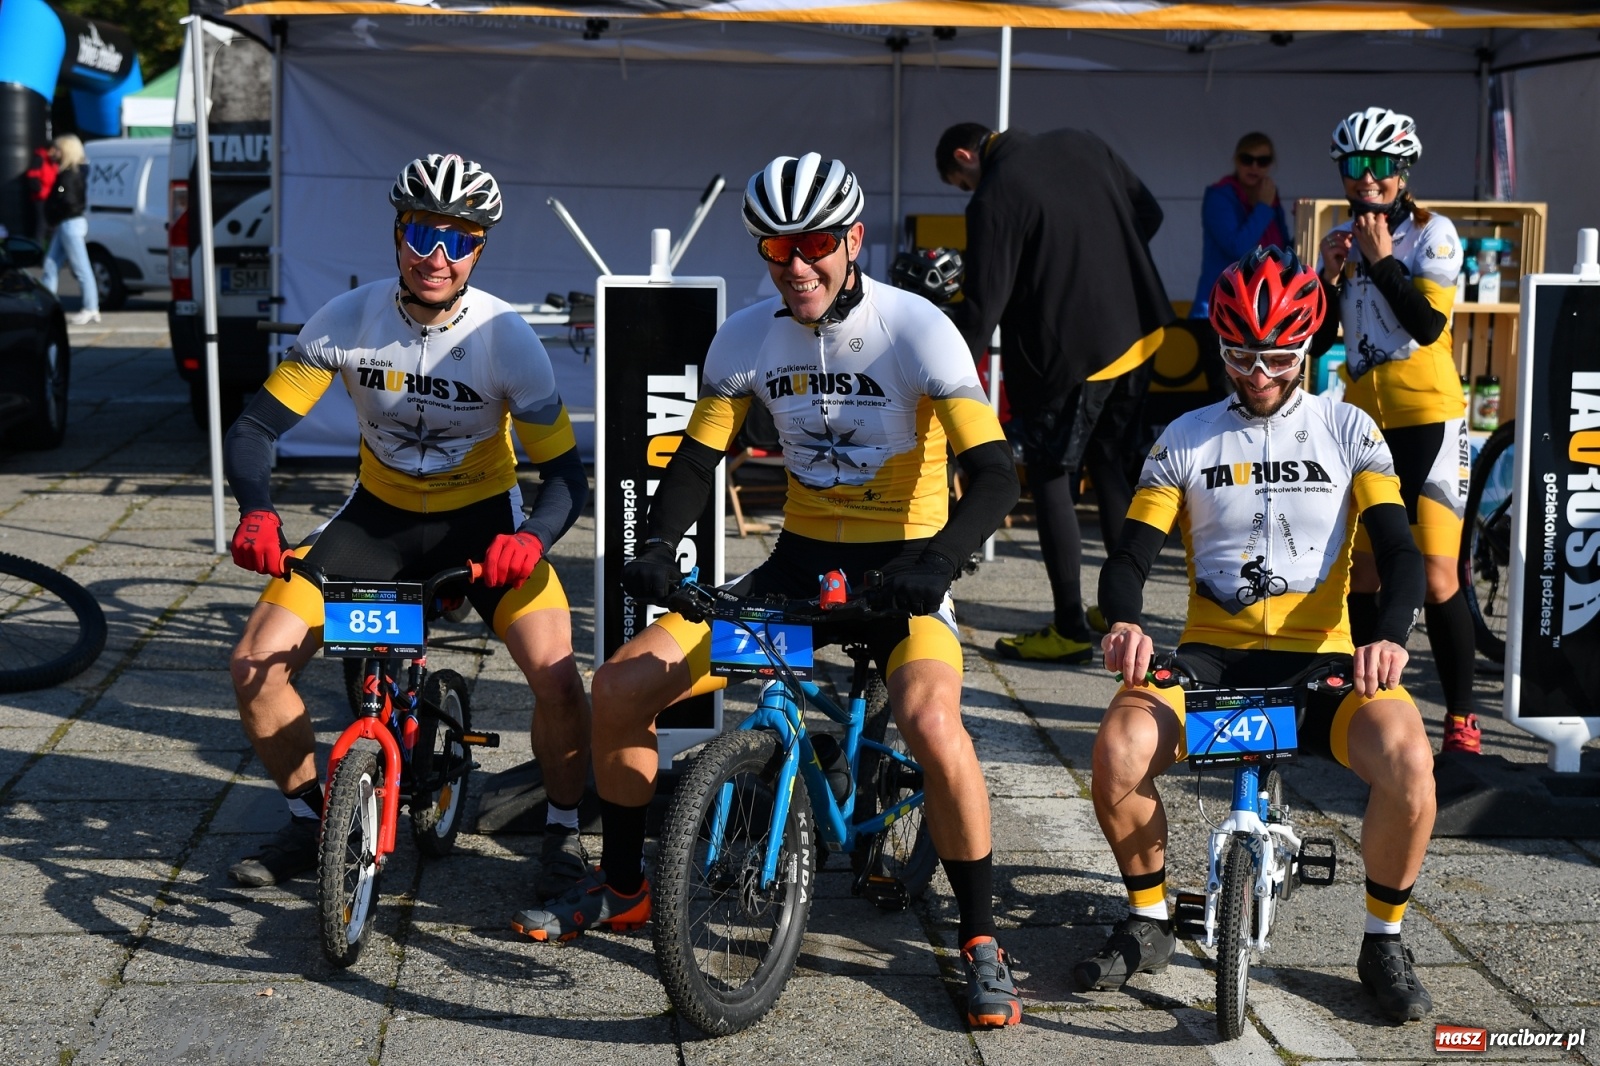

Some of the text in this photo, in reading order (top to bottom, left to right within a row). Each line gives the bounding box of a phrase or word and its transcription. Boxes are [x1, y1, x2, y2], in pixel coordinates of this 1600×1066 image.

[360, 358, 393, 368] B. Sobik
[357, 367, 450, 400] TAURUS
[766, 373, 853, 400] TAURUS
[792, 417, 806, 425] NW
[853, 418, 865, 427] NE
[1201, 460, 1300, 490] TAURUS
[1304, 486, 1332, 494] jedziesz
[620, 479, 637, 566] gdziekolwi
[1278, 513, 1298, 558] cycling team
[1540, 472, 1558, 636] gdziekolwiek jedziesz
[349, 609, 400, 635] 851
[1213, 715, 1270, 743] 847
[797, 811, 810, 904] KENDA
